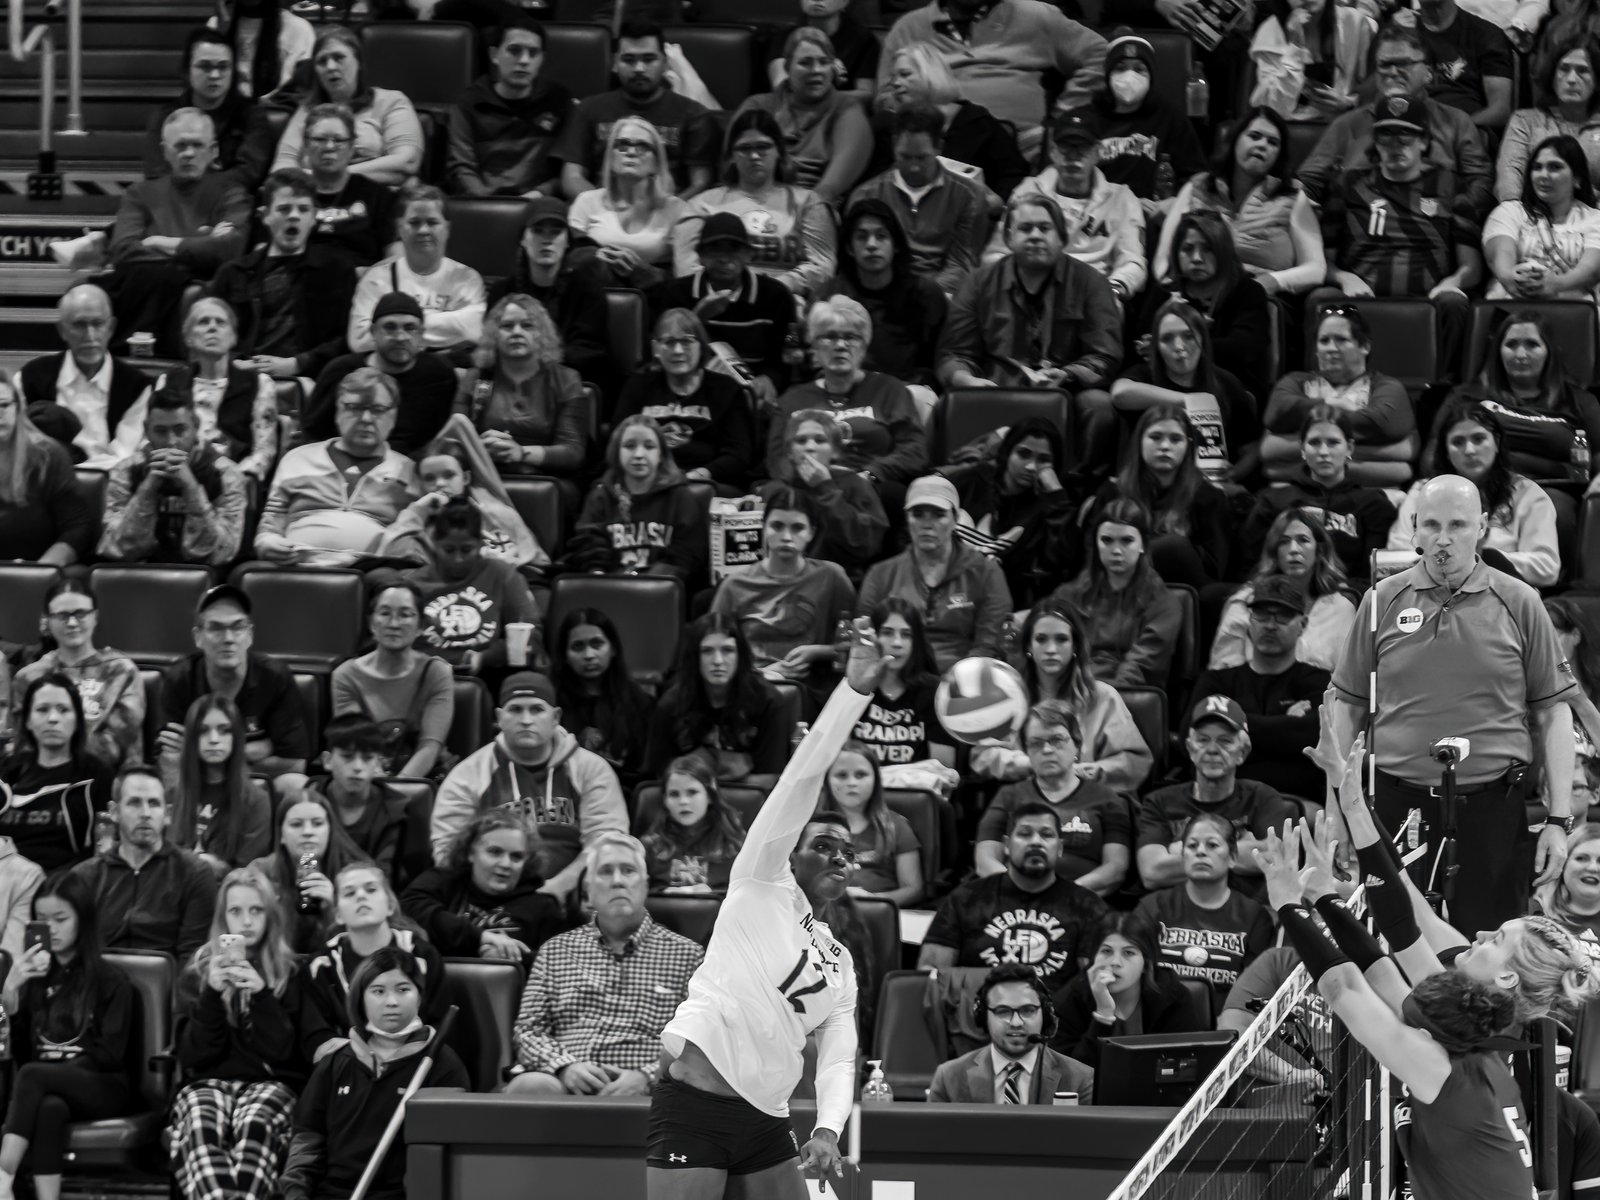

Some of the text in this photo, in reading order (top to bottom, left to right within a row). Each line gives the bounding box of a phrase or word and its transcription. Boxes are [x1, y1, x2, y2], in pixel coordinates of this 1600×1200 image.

[0, 236, 31, 256] CH
[1206, 695, 1231, 713] N
[983, 908, 1066, 942] NEBRASKA
[1502, 1106, 1533, 1169] 5
